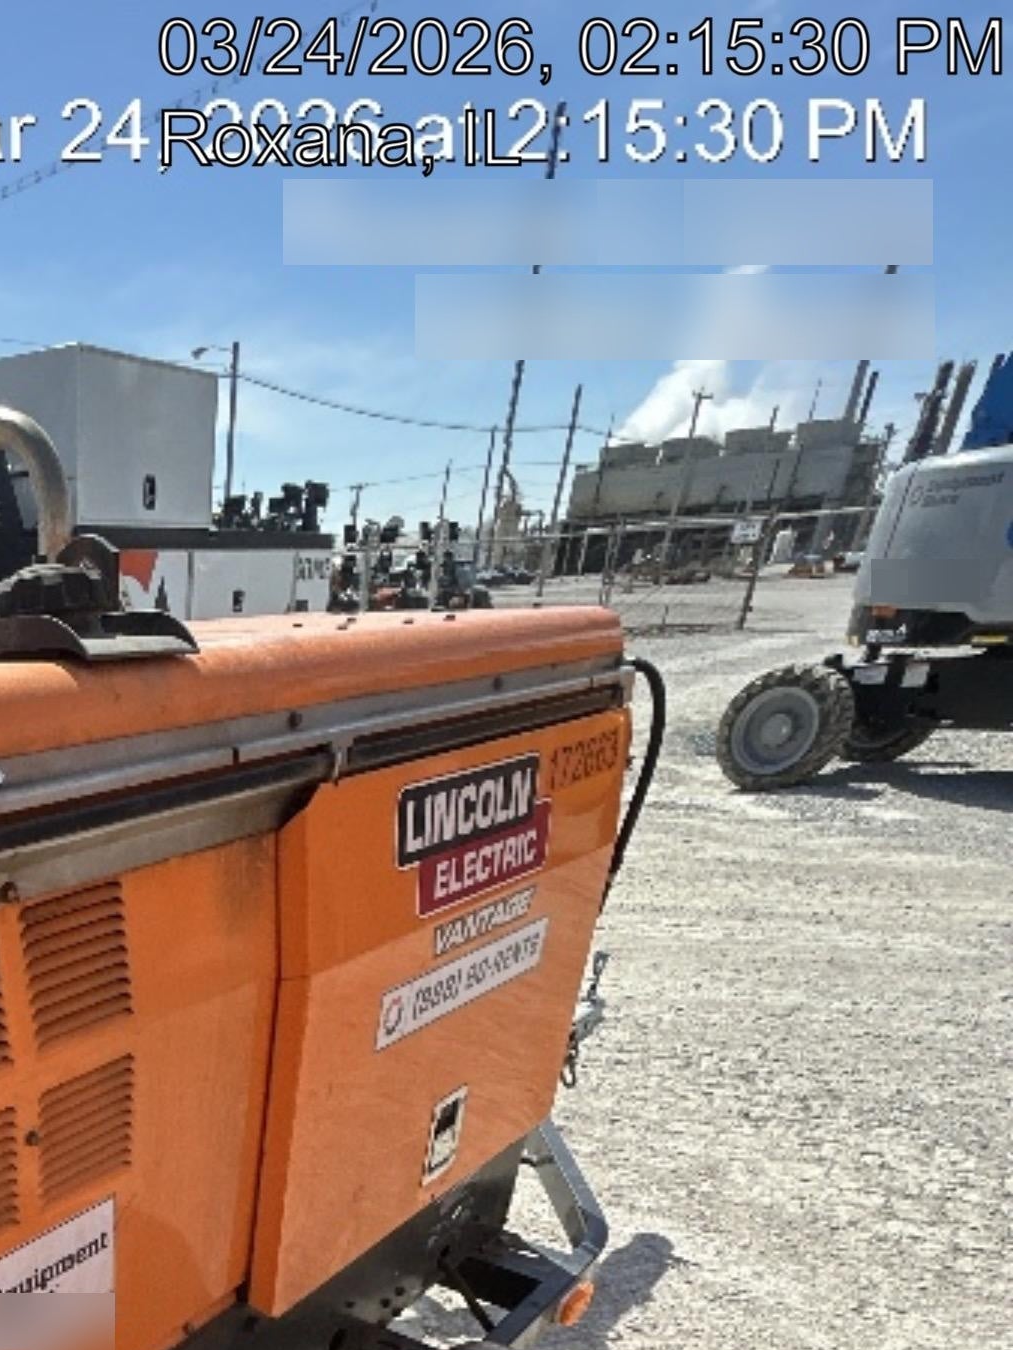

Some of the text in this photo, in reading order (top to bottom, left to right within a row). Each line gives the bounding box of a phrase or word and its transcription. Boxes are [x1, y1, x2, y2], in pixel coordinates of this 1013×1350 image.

[405, 766, 533, 855] LINCOLN
[432, 828, 538, 901] ELECTRIC
[434, 886, 537, 957] VANTAGE
